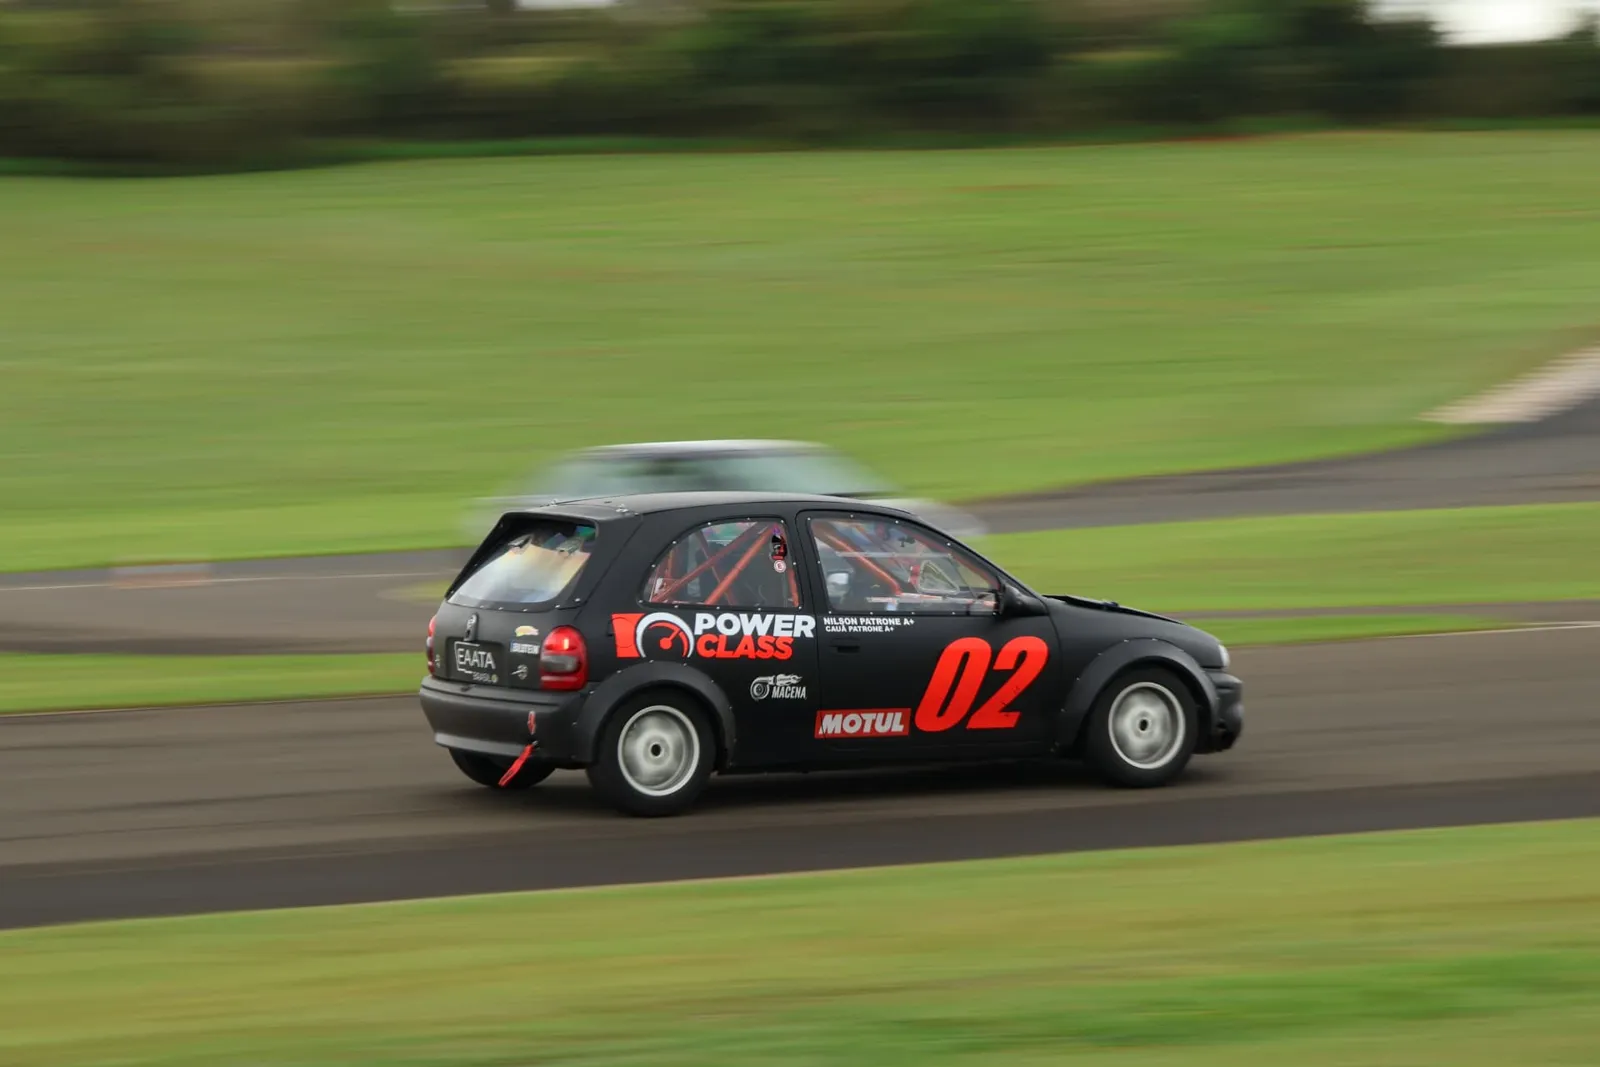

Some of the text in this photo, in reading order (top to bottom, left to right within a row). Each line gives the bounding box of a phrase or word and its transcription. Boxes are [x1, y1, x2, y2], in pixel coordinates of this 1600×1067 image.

[694, 613, 816, 638] POWER
[823, 617, 915, 626] NILSON PATRONE A+
[457, 648, 497, 669] EAATA
[696, 634, 794, 660] CLASS
[771, 686, 806, 699] MACENA
[914, 635, 1049, 732] 02
[818, 712, 904, 735] MOTUL
